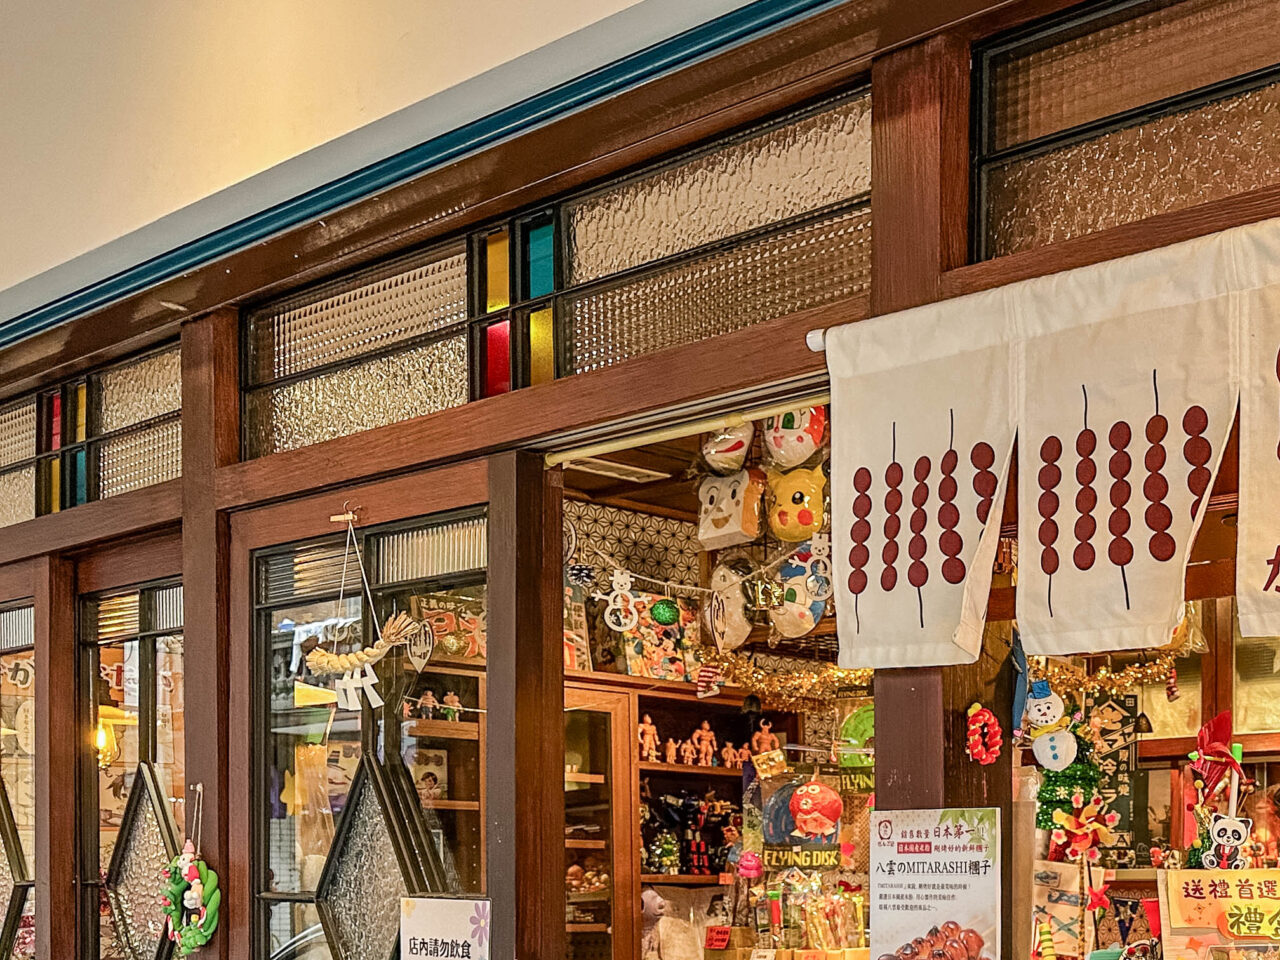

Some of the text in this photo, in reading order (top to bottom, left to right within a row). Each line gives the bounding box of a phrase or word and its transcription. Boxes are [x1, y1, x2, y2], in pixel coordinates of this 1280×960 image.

[841, 774, 874, 790] FLYIN
[764, 850, 839, 867] FLYING DISK
[408, 936, 472, 960] 店內請勿飲食
